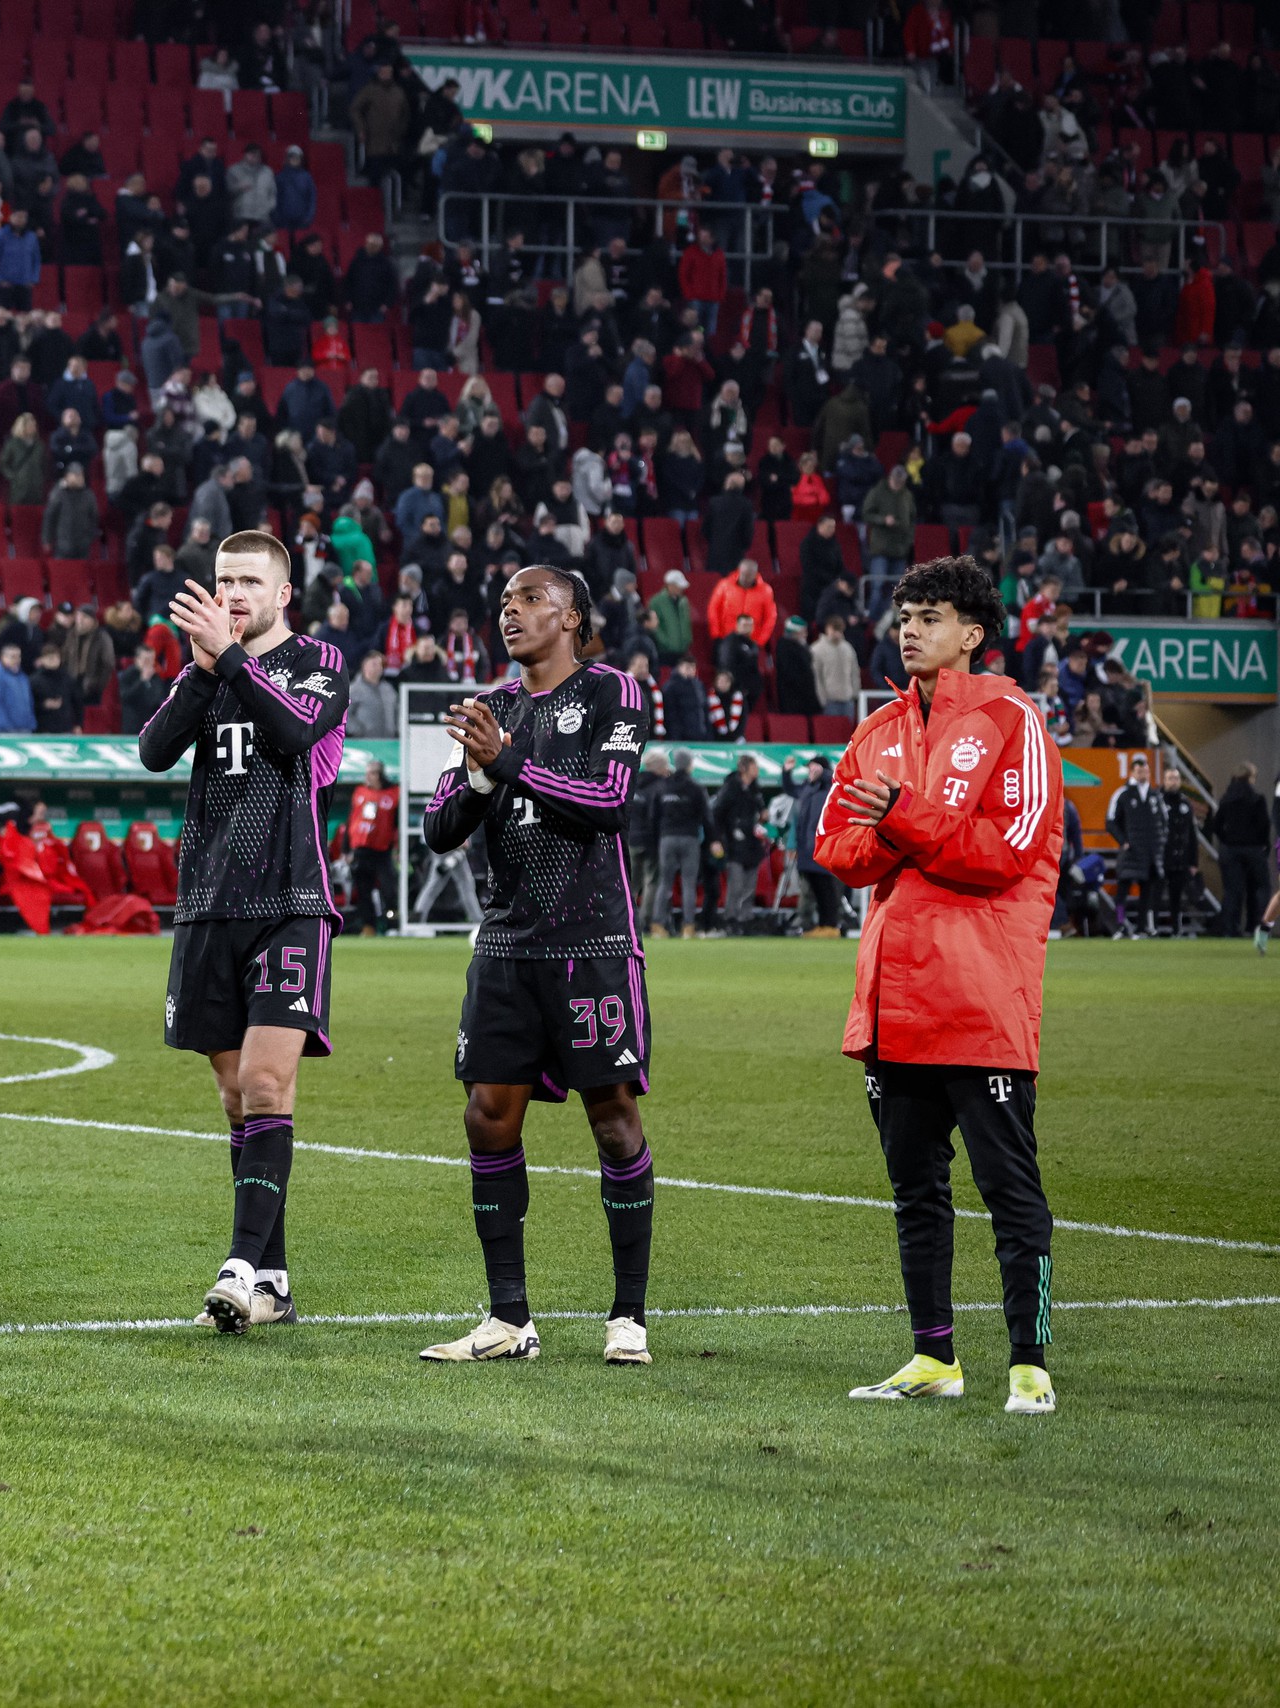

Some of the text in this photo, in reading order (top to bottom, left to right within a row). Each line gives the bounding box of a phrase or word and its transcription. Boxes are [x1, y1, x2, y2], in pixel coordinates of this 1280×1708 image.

[687, 76, 895, 120] LEW Business Club
[613, 721, 637, 735] ROT
[254, 946, 307, 993] 15
[569, 994, 627, 1049] 39
[243, 1177, 280, 1194] BAYERN
[612, 1197, 652, 1210] BAYERN
